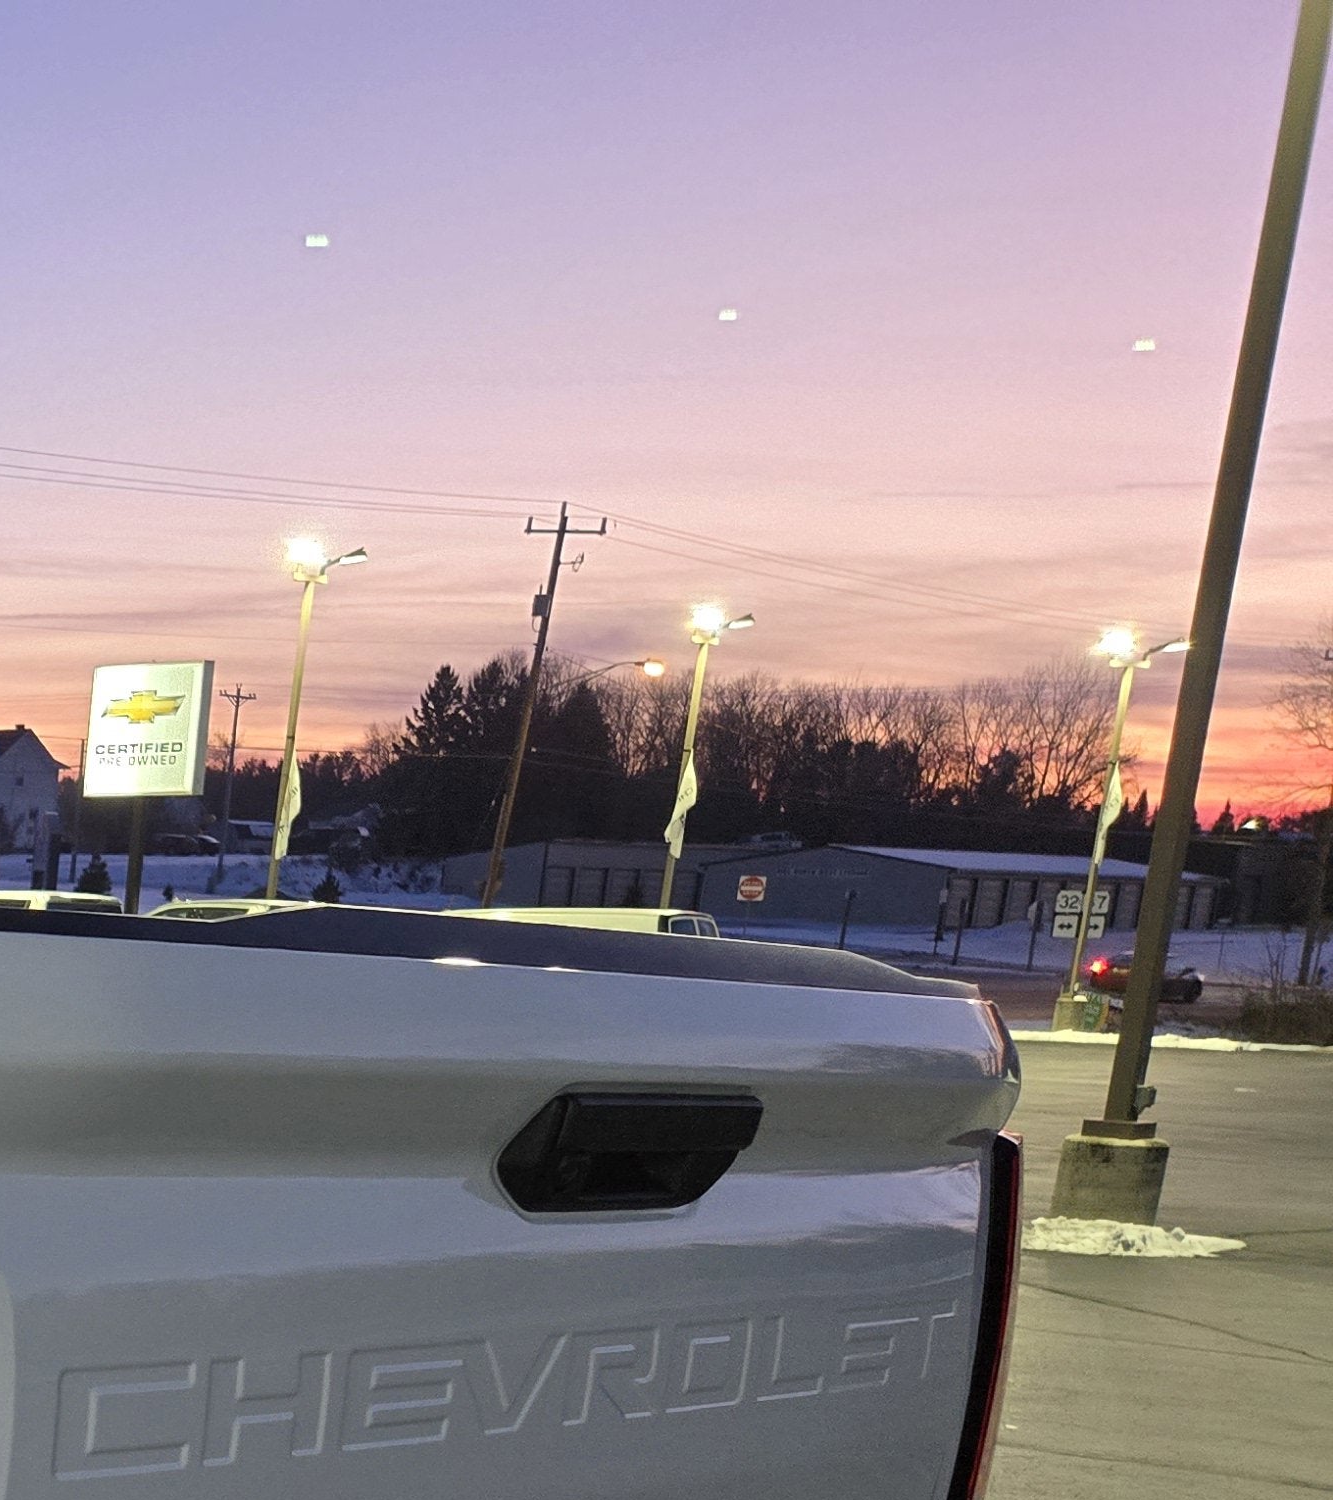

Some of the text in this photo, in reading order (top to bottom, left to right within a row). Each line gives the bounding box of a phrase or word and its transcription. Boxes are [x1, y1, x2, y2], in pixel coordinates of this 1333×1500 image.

[95, 742, 183, 755] CERTIFIED
[128, 755, 177, 766] OWNED
[1058, 894, 1080, 910] 32
[51, 1296, 960, 1482] CHEVROLET
